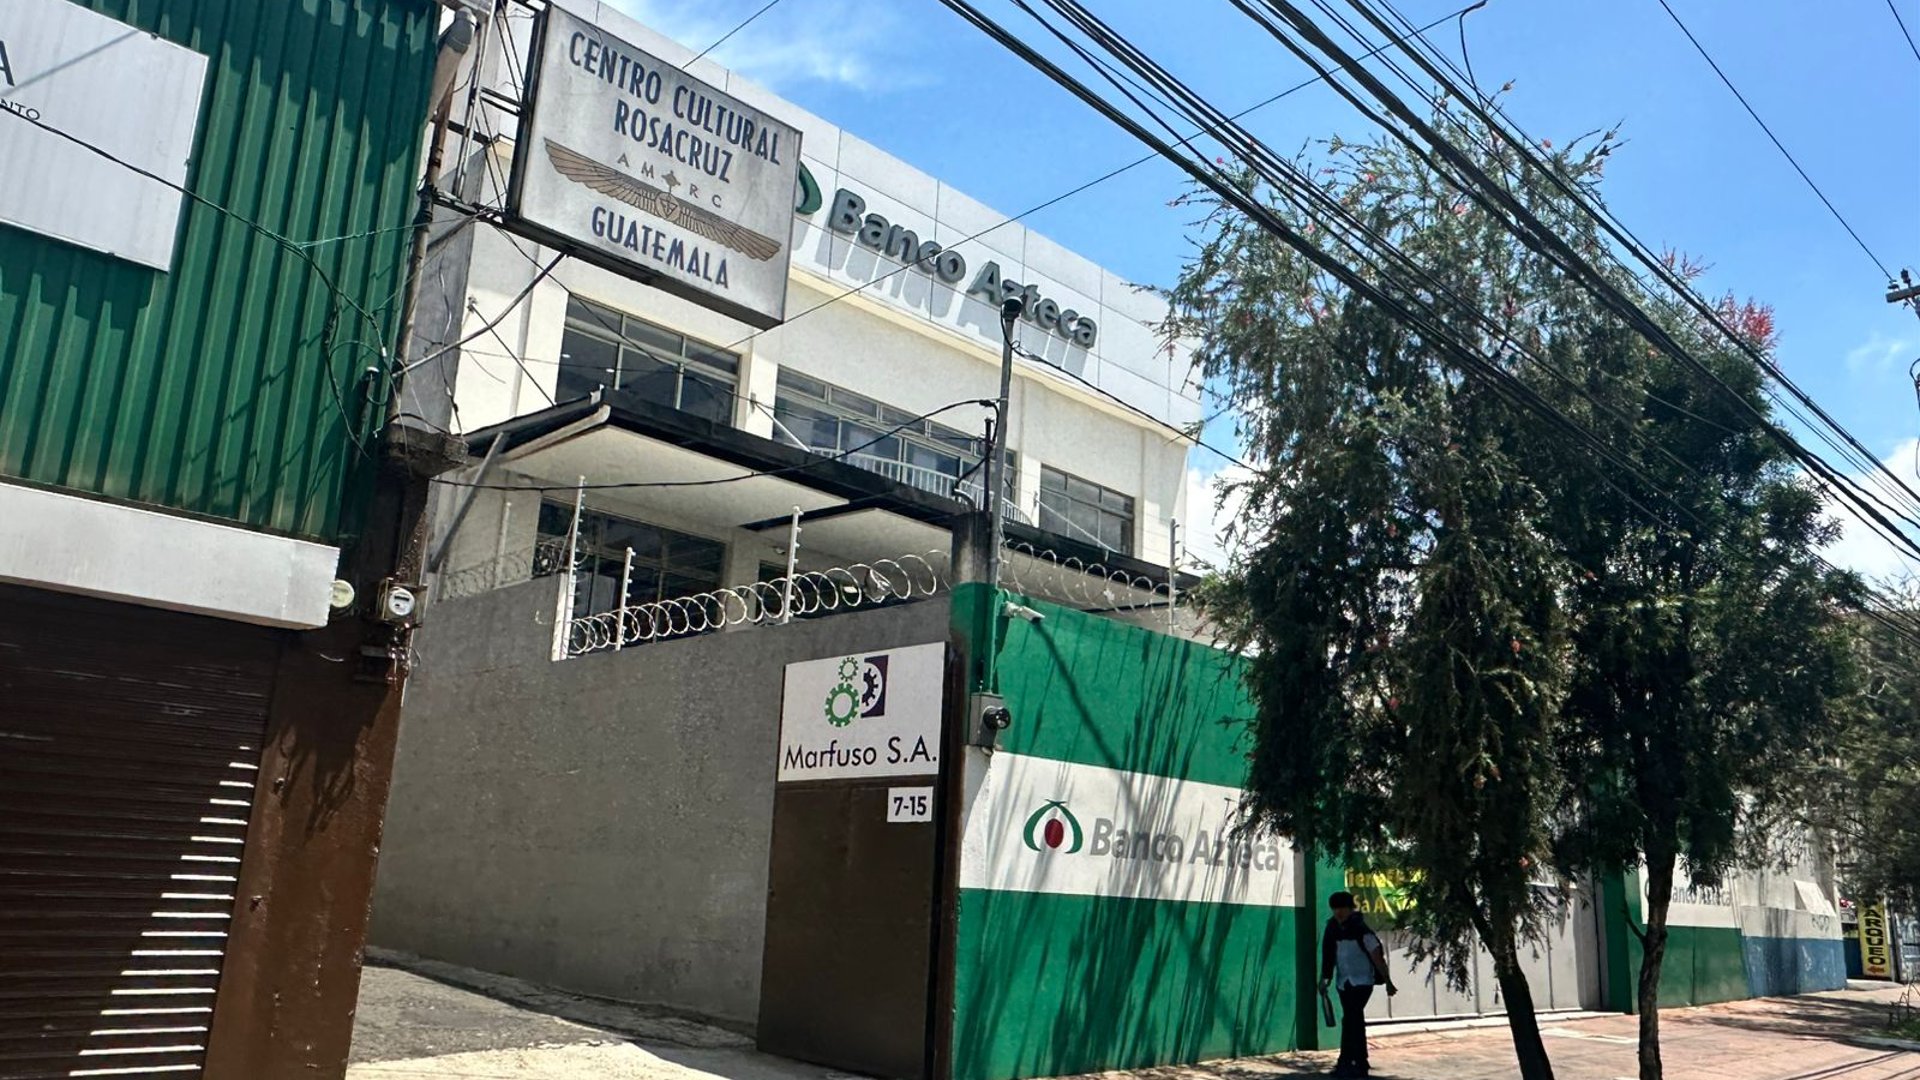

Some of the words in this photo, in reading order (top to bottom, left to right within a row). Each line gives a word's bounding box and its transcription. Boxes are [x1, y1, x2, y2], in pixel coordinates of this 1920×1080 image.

[568, 31, 662, 105] CENTRO
[672, 85, 780, 166] CULTURAL
[614, 99, 733, 184] ROSACRUZ
[591, 206, 729, 289] GUATEMALA
[828, 188, 966, 283] Banco
[966, 260, 1098, 349] Azteca
[784, 739, 877, 770] Marfuso
[887, 734, 937, 764] S.A.
[893, 796, 927, 817] 7-15
[1090, 817, 1184, 863] Banco
[1188, 830, 1280, 872] Azteca
